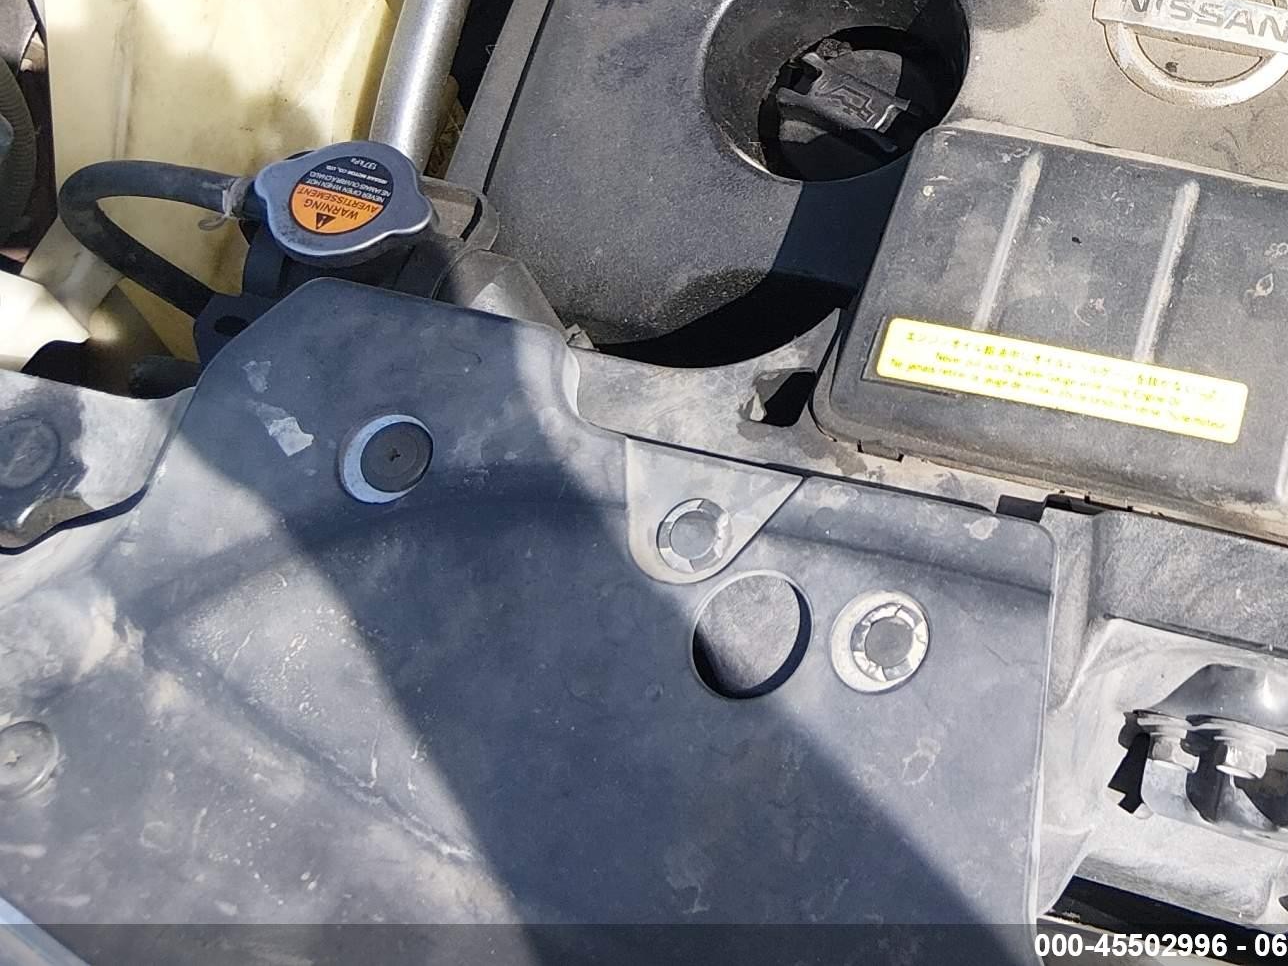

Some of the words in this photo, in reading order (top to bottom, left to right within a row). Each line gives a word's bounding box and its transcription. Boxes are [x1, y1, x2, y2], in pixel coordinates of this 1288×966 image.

[298, 187, 378, 212] AVERTISSEMENT
[361, 192, 385, 202] NEVER
[304, 199, 358, 220] WARNING
